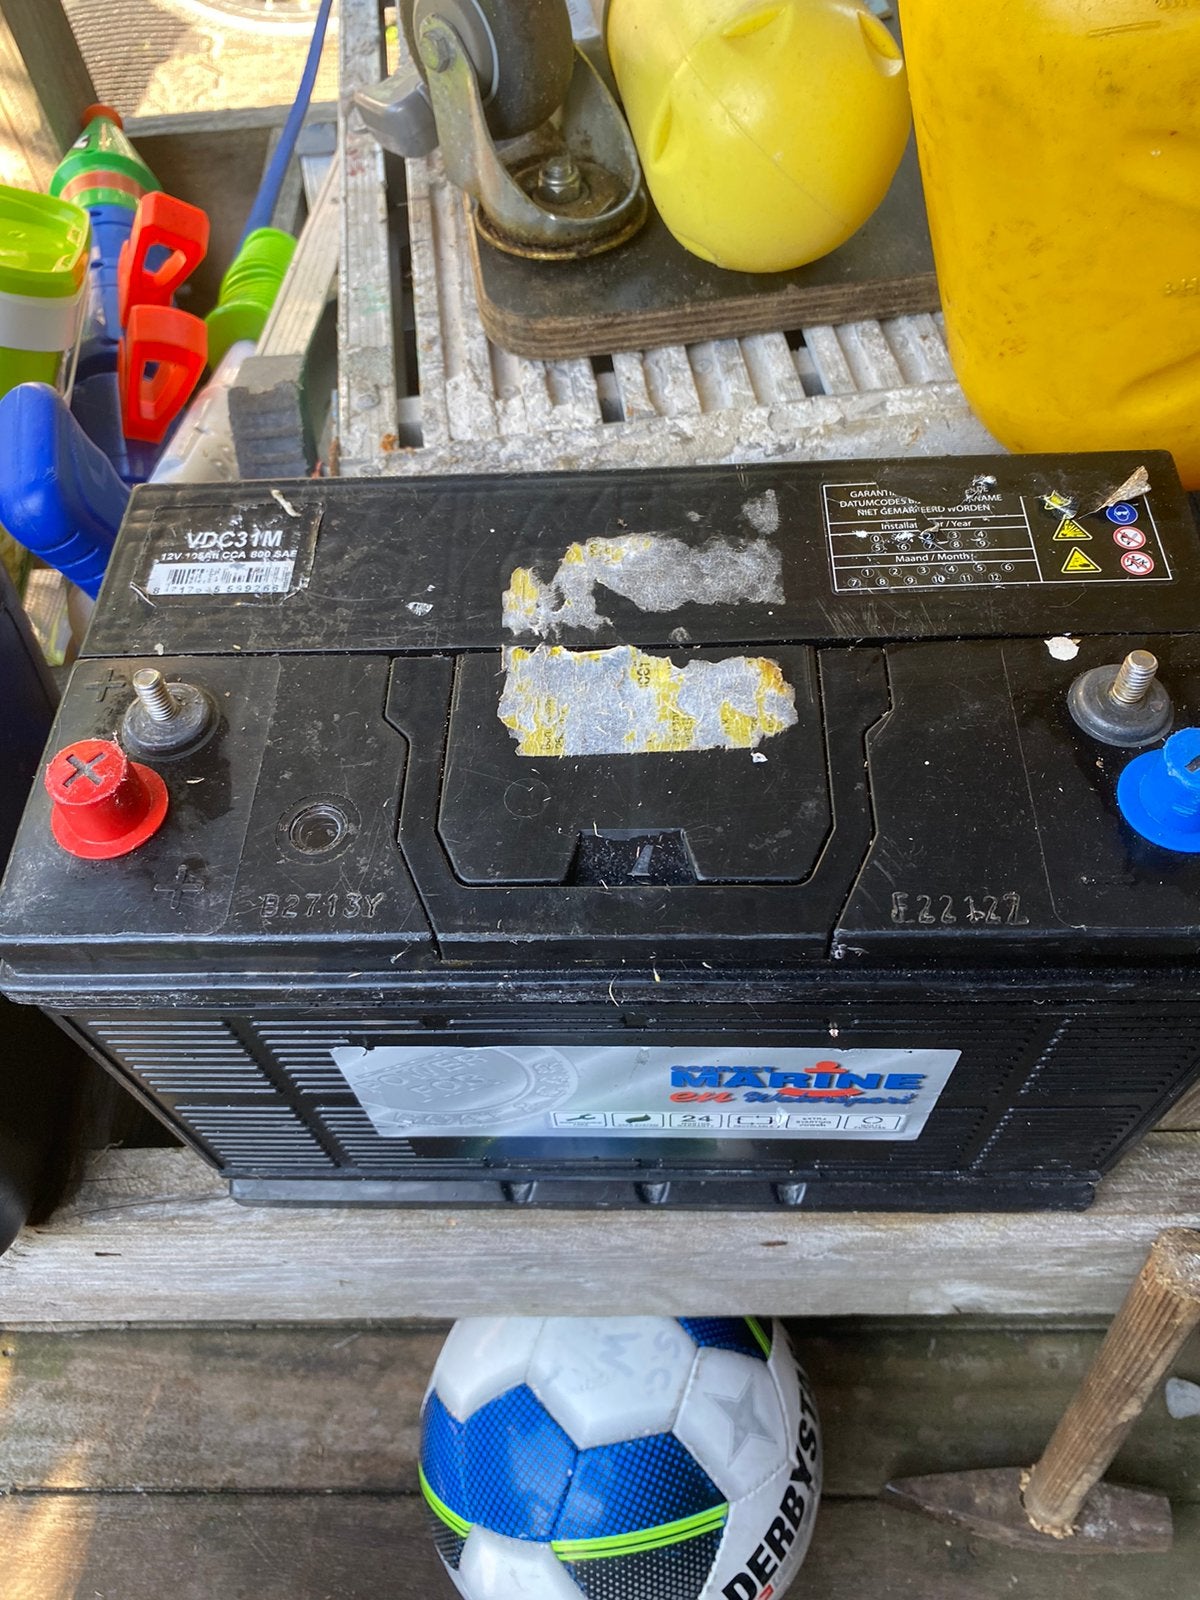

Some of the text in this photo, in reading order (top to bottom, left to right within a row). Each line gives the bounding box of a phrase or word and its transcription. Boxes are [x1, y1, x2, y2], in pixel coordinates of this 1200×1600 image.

[839, 497, 907, 508] DATUMCODES
[856, 507, 879, 517] NIET
[951, 520, 973, 528] Year
[186, 529, 284, 549] VDC31M
[161, 551, 183, 561] 12V
[222, 550, 246, 559] CCA
[272, 549, 298, 558] SAE
[894, 553, 929, 563] Maand
[936, 552, 971, 561] Month
[670, 1071, 926, 1090] MARINE
[681, 1114, 712, 1123] 24
